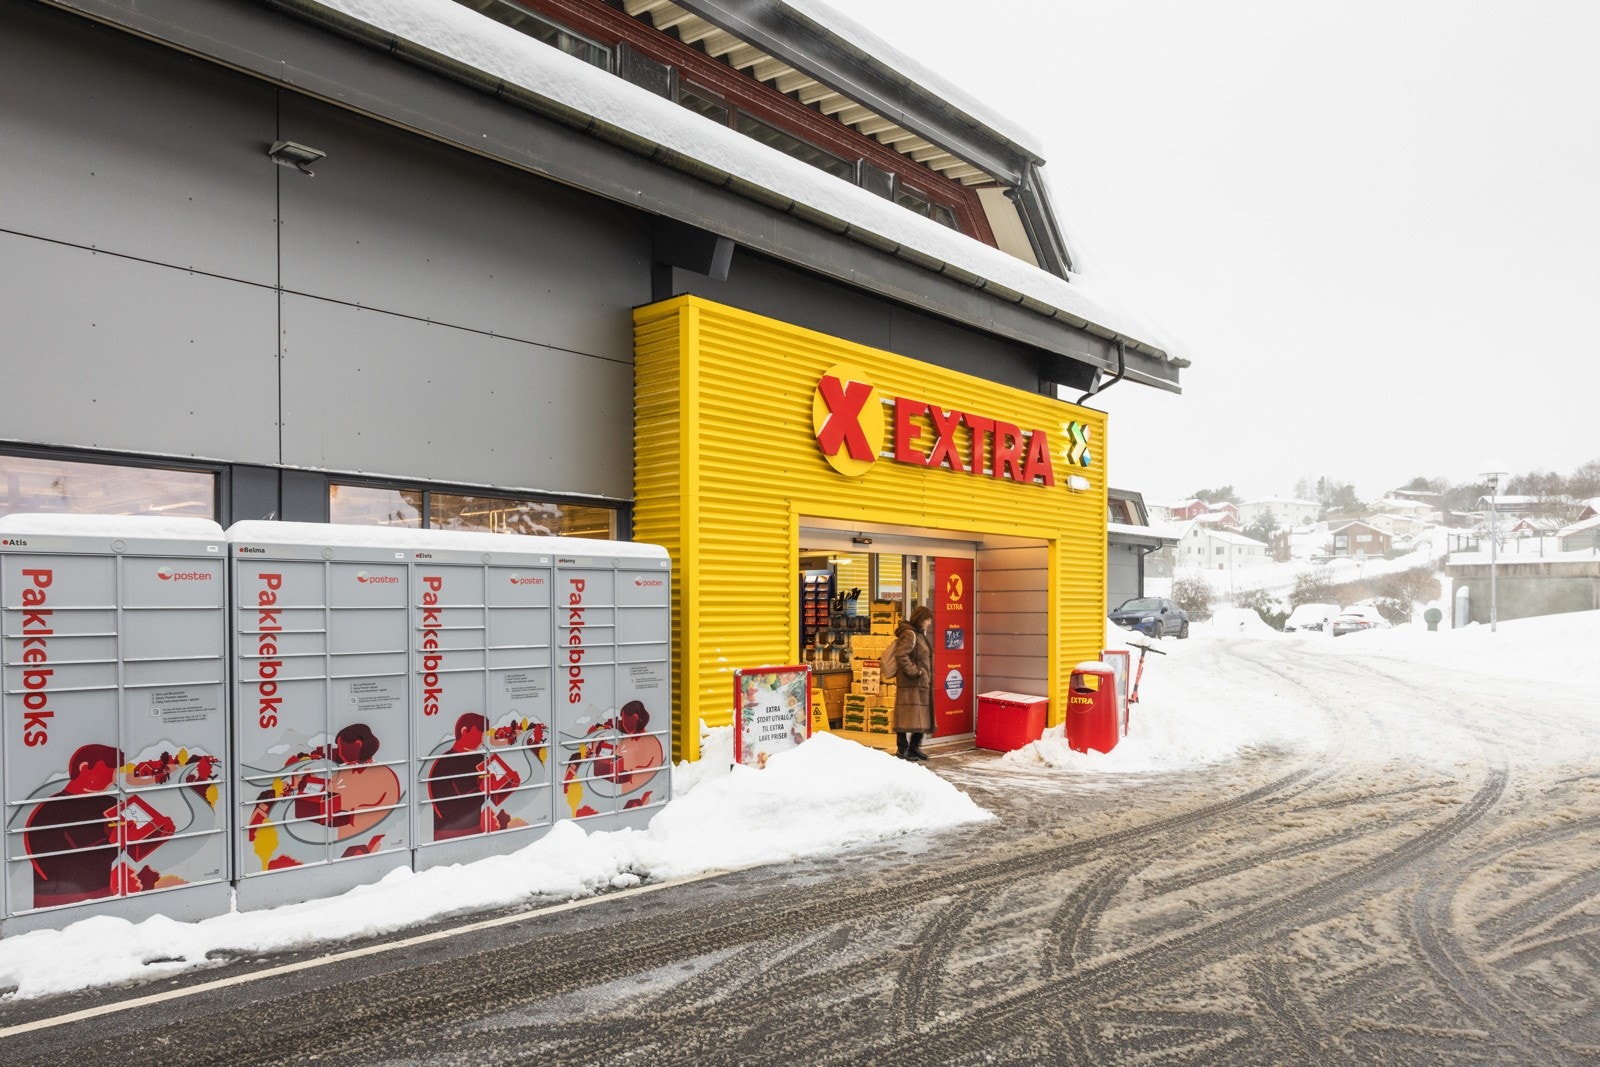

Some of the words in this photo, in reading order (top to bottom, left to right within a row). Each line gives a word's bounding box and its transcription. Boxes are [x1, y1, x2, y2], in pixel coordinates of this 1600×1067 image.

[895, 397, 1055, 487] EXTRA
[174, 571, 211, 581] posten
[370, 575, 399, 584] posten
[520, 577, 544, 585] posten
[643, 579, 663, 587] posten
[946, 603, 963, 611] EXTRA
[569, 579, 585, 704] Pakkeboks
[258, 573, 283, 729] Pakkeboks
[422, 576, 442, 717] Pakkeboks
[22, 569, 54, 747] Pakkeboks
[1070, 696, 1094, 705] EXTRA
[757, 715, 771, 723] STORT
[769, 723, 785, 731] EXTRA
[771, 732, 788, 741] PRISER
